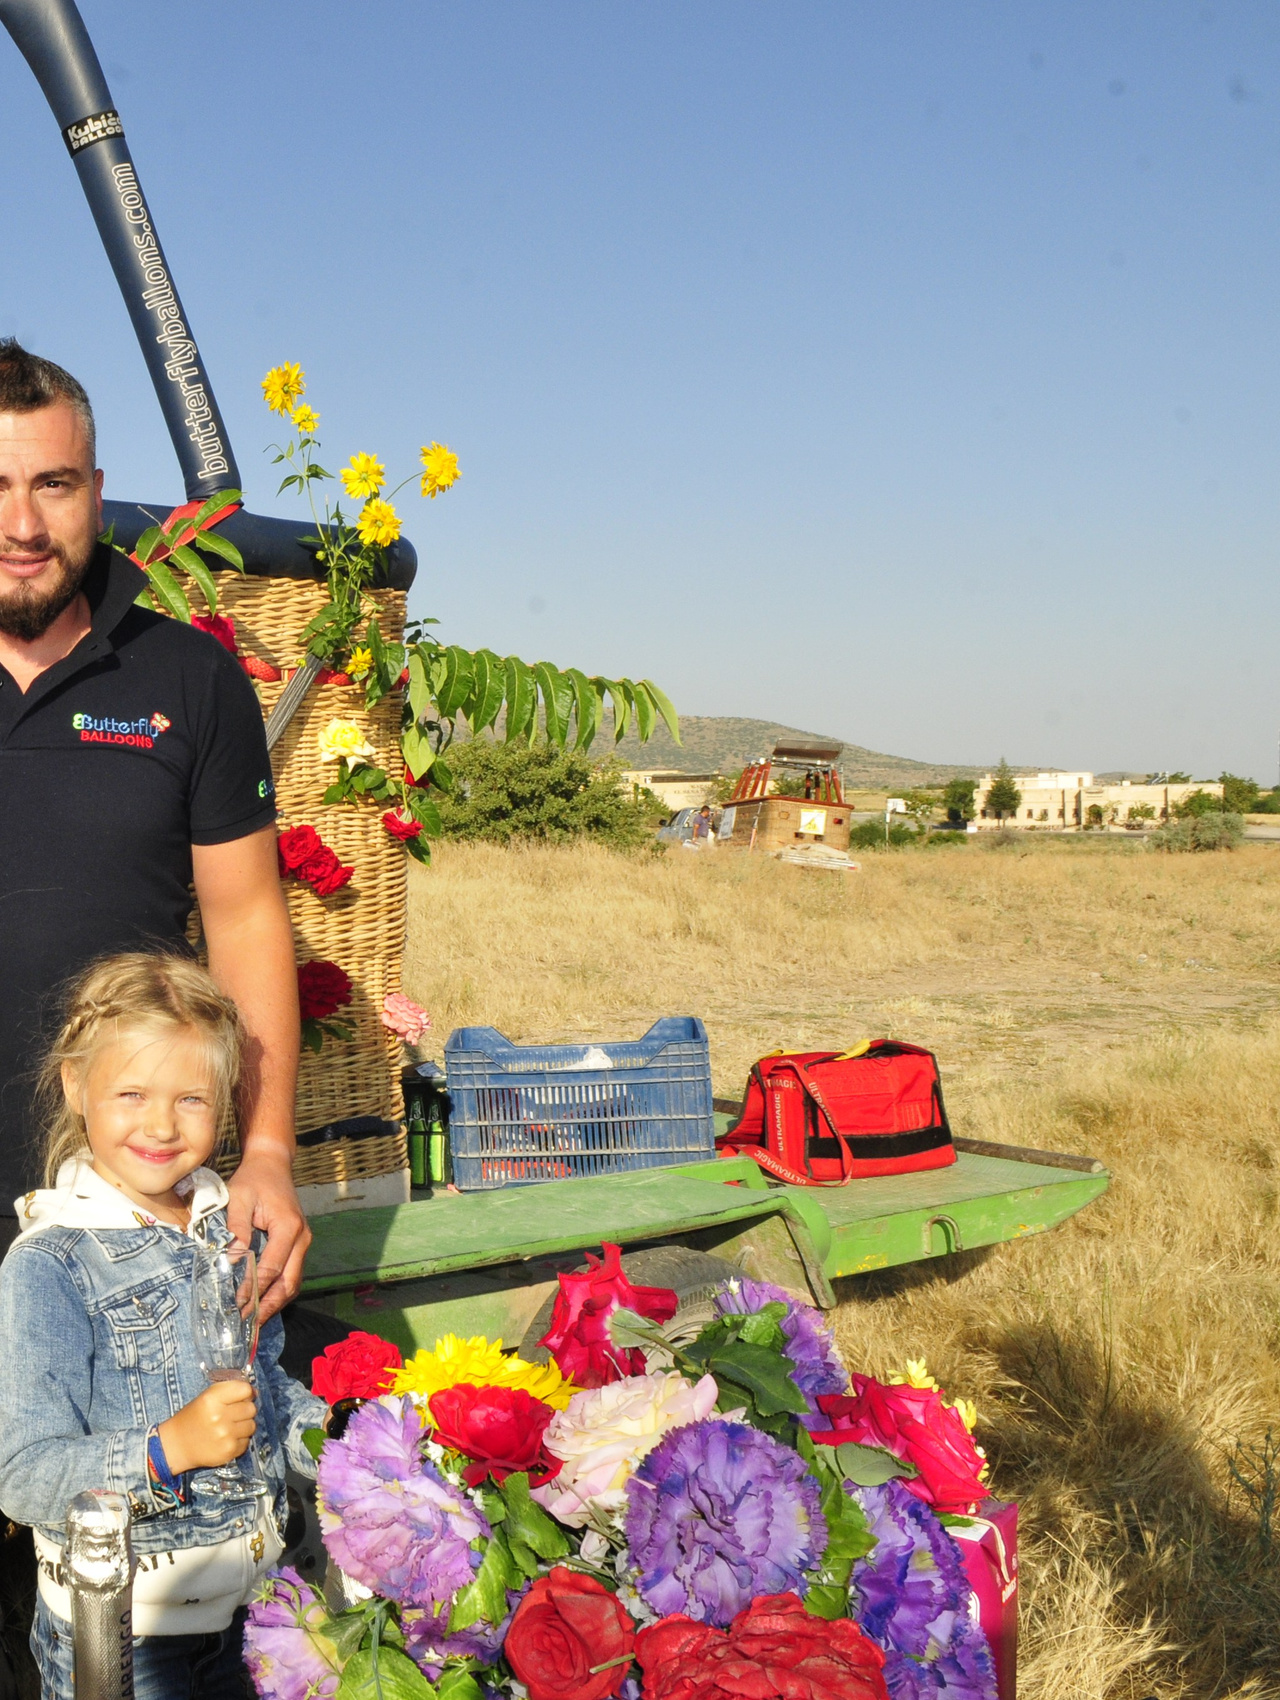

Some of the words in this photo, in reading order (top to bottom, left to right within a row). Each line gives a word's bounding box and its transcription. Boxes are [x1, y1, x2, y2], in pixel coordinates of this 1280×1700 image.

[111, 162, 229, 480] butterflyballons.com
[73, 713, 159, 743] Butterfly
[80, 729, 153, 749] BALLOONS
[754, 1149, 807, 1185] ULTRAMAGIC
[120, 1609, 133, 1700] ARENGO
